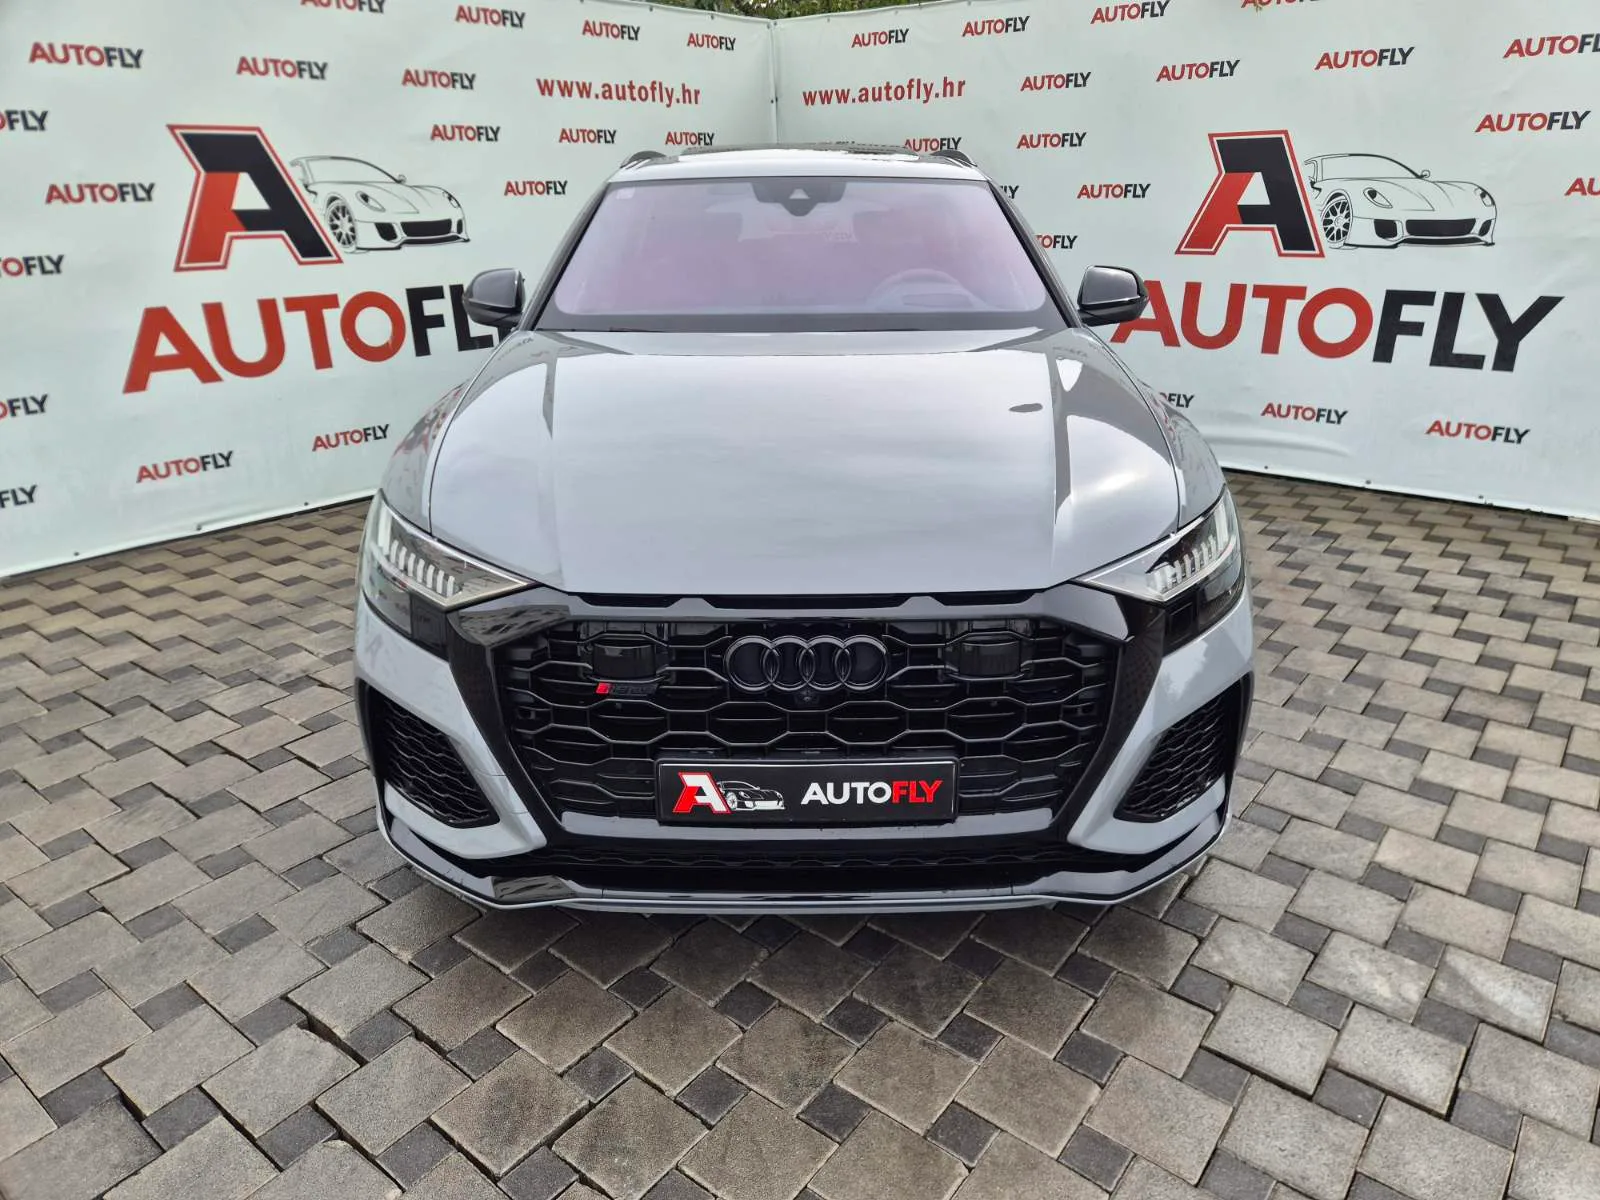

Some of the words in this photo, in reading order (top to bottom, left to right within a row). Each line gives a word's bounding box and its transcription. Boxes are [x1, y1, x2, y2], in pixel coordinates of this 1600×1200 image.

[455, 5, 526, 29] AUTOFLY
[1090, 0, 1171, 24] AUTOFLY
[582, 20, 640, 41] AUTOFLY
[962, 16, 1030, 37] AUTOFLY
[687, 33, 736, 51] AUTOFLY
[851, 28, 909, 48] AUTOFLY
[29, 42, 144, 69] AUTOFLY
[1315, 47, 1415, 70] AUTOFLY
[236, 56, 328, 80] AUTOFLY
[1156, 60, 1240, 82] AUTOFLY
[401, 69, 476, 90] AUTOFLY
[1020, 72, 1091, 91] AUTOFLY
[536, 78, 700, 108] www.autofly.hr
[802, 76, 966, 107] www.autofly.hr
[0, 110, 48, 132] FLY
[1474, 111, 1591, 133] AUTOFLY
[430, 124, 501, 142] AUTOFLY
[559, 128, 617, 144] AUTOFLY
[665, 131, 715, 146] AUTOFLY
[1017, 132, 1087, 149] AUTOFLY
[905, 137, 962, 153] AUTOFLY
[45, 183, 155, 204] AUTOFLY
[504, 180, 568, 196] AUTOFLY
[1077, 183, 1151, 199] AUTOFLY
[0, 254, 64, 277] OFLY
[1110, 279, 1565, 372] AUTOFLY
[123, 284, 510, 393] AUTOFL
[1261, 402, 1348, 425] AUTOFLY
[312, 424, 389, 452] AUTOFLY
[1425, 420, 1531, 445] AUTOFLY
[136, 450, 233, 483] AUTOFLY
[801, 779, 943, 806] AUTOFLY
